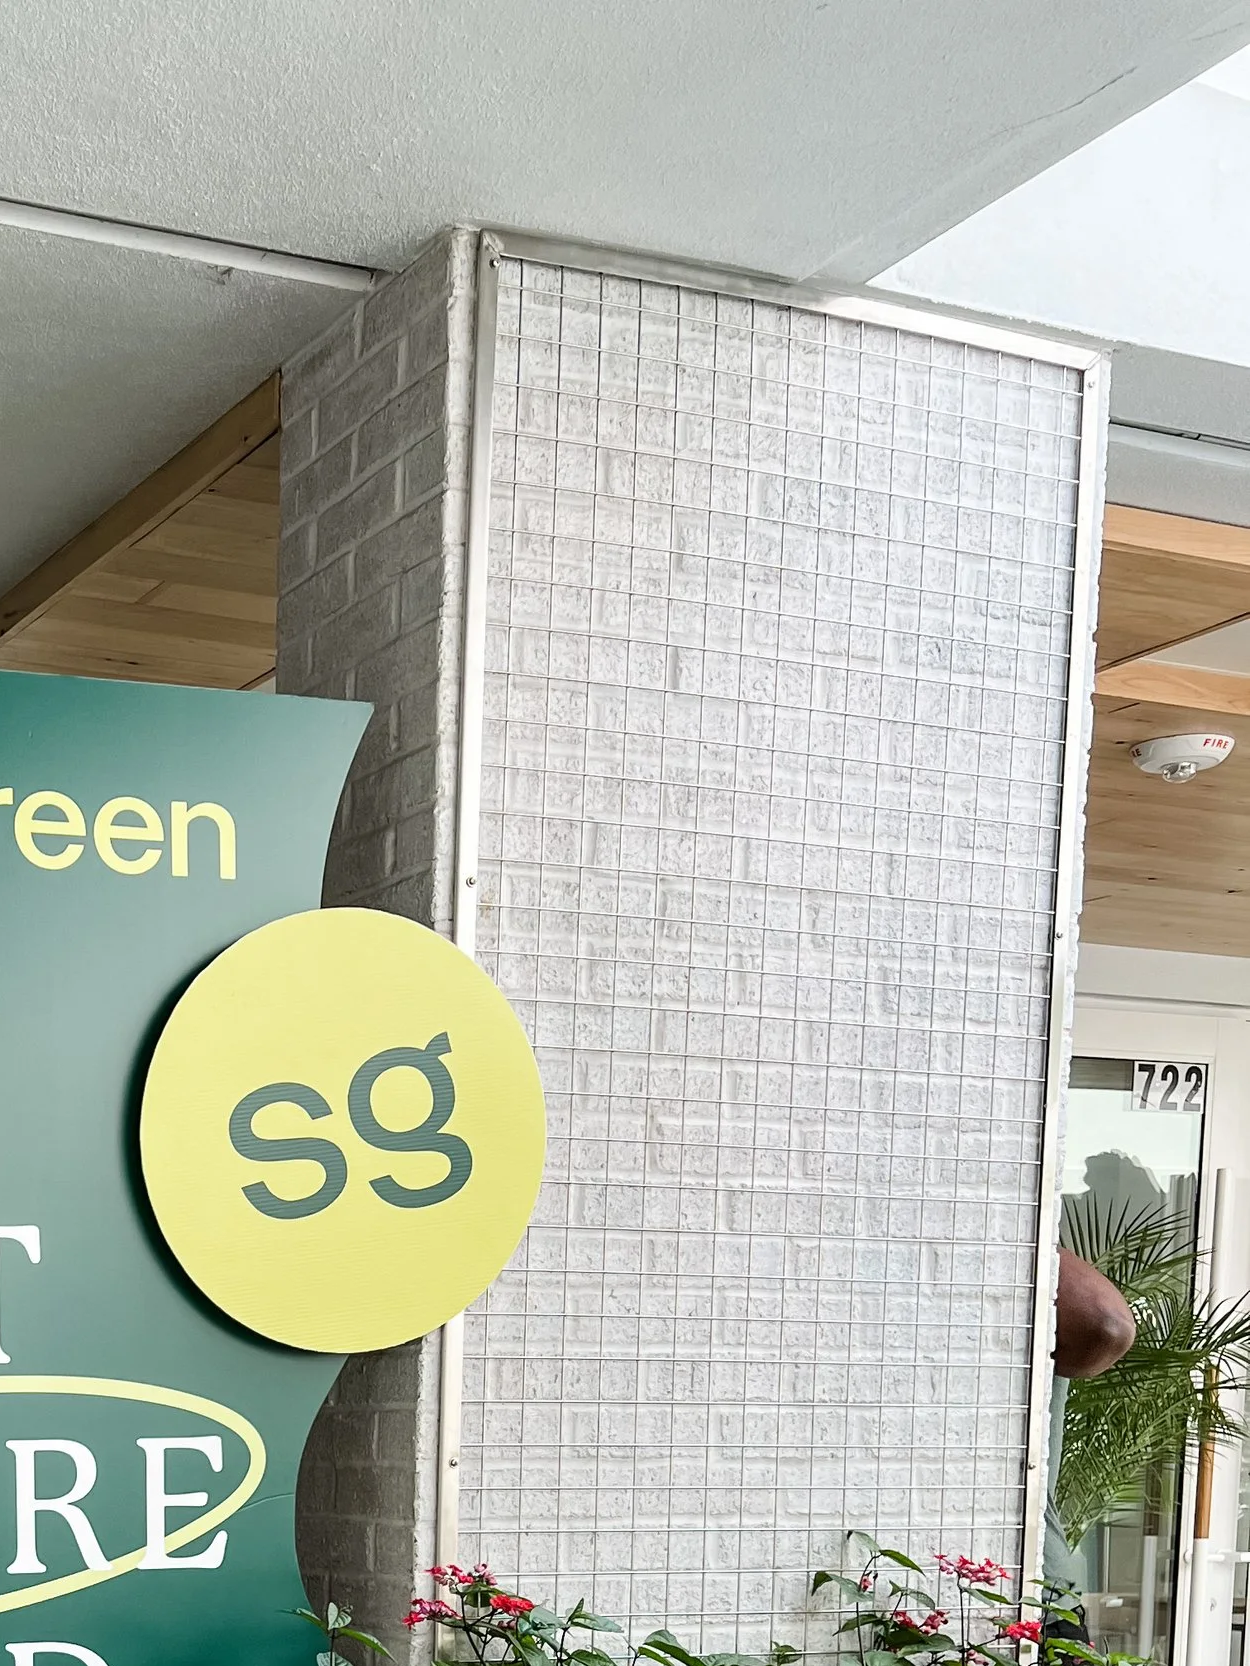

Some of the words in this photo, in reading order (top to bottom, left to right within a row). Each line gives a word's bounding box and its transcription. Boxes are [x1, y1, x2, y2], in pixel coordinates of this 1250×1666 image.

[1202, 738, 1230, 750] FIRE
[1137, 1063, 1203, 1112] 722
[228, 1031, 473, 1220] sg
